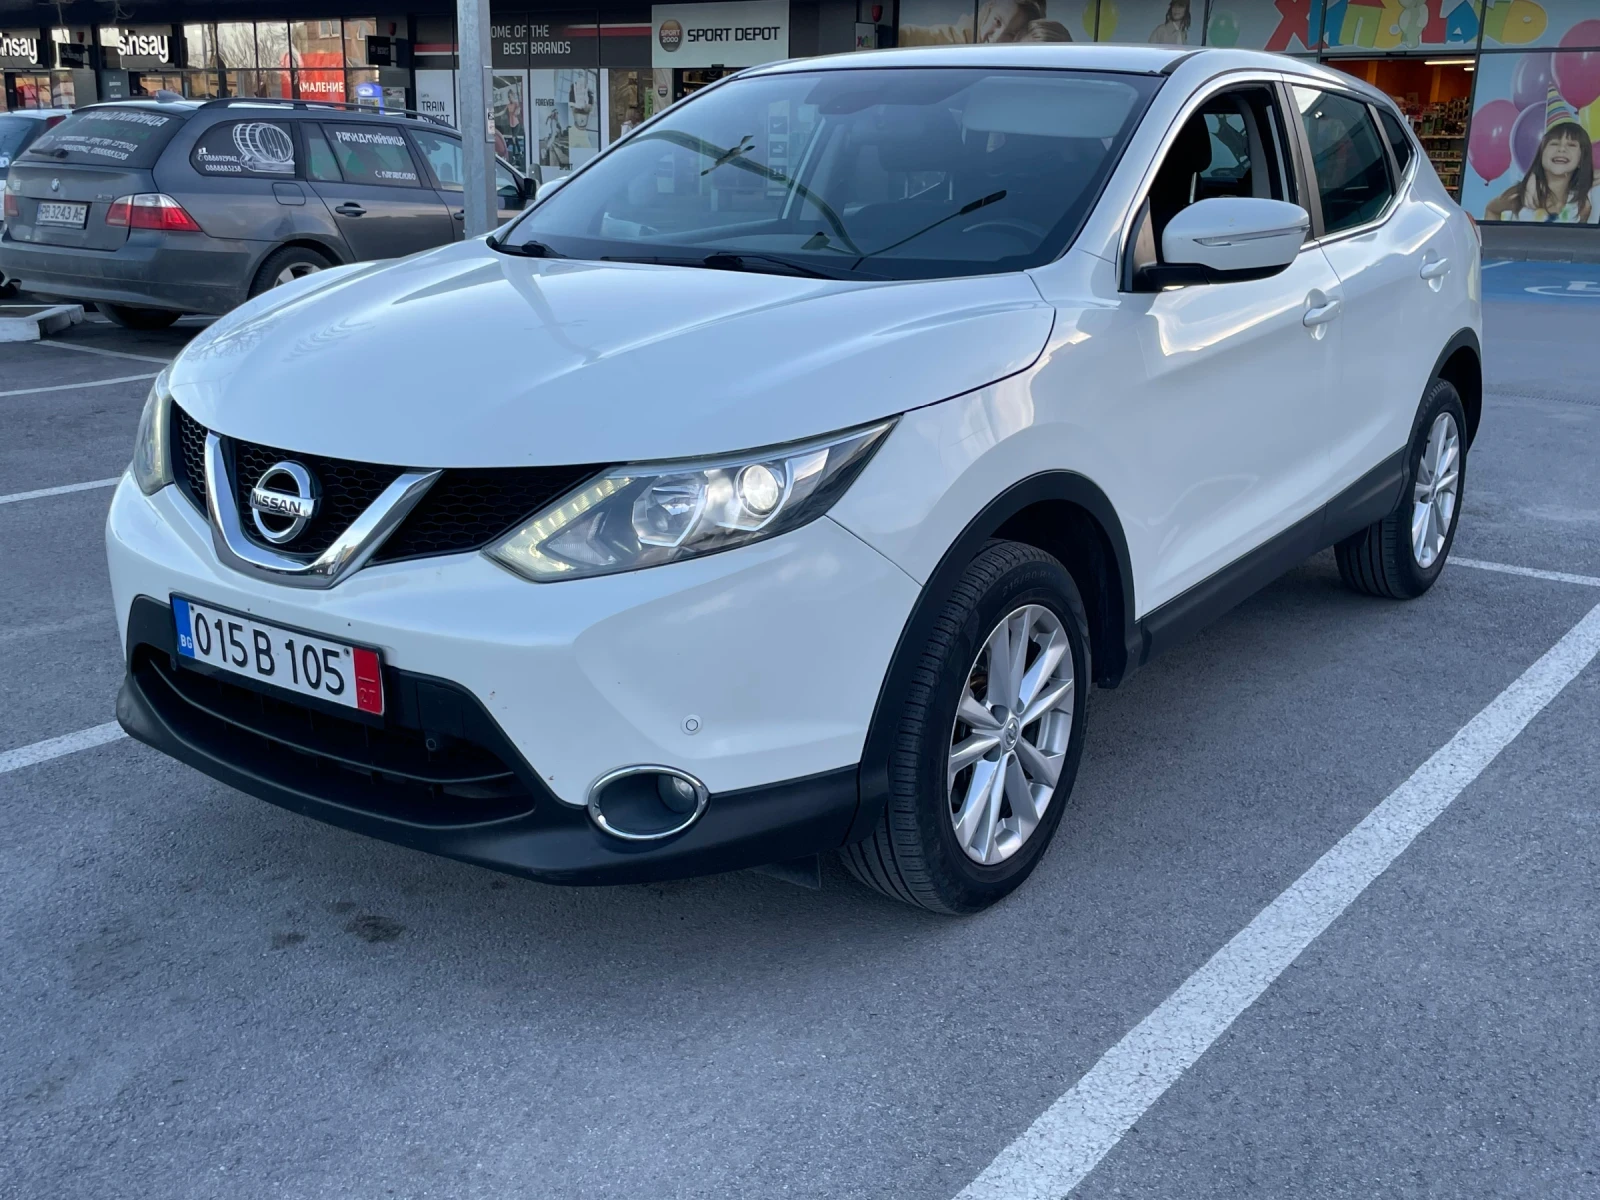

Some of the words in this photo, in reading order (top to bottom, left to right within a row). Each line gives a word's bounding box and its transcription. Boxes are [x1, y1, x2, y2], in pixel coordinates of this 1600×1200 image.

[490, 26, 511, 38] OME
[514, 25, 527, 38] OF
[530, 24, 550, 37] THE
[687, 28, 731, 42] SPORT
[735, 26, 780, 41] DEPOT
[0, 32, 38, 64] insay
[117, 29, 169, 63] sinsay
[503, 42, 528, 55] BEST
[531, 41, 571, 54] BRANDS
[421, 101, 445, 111] TRAIN
[535, 98, 555, 106] FOREVER
[252, 493, 302, 514] NISSAN
[180, 633, 194, 649] BG
